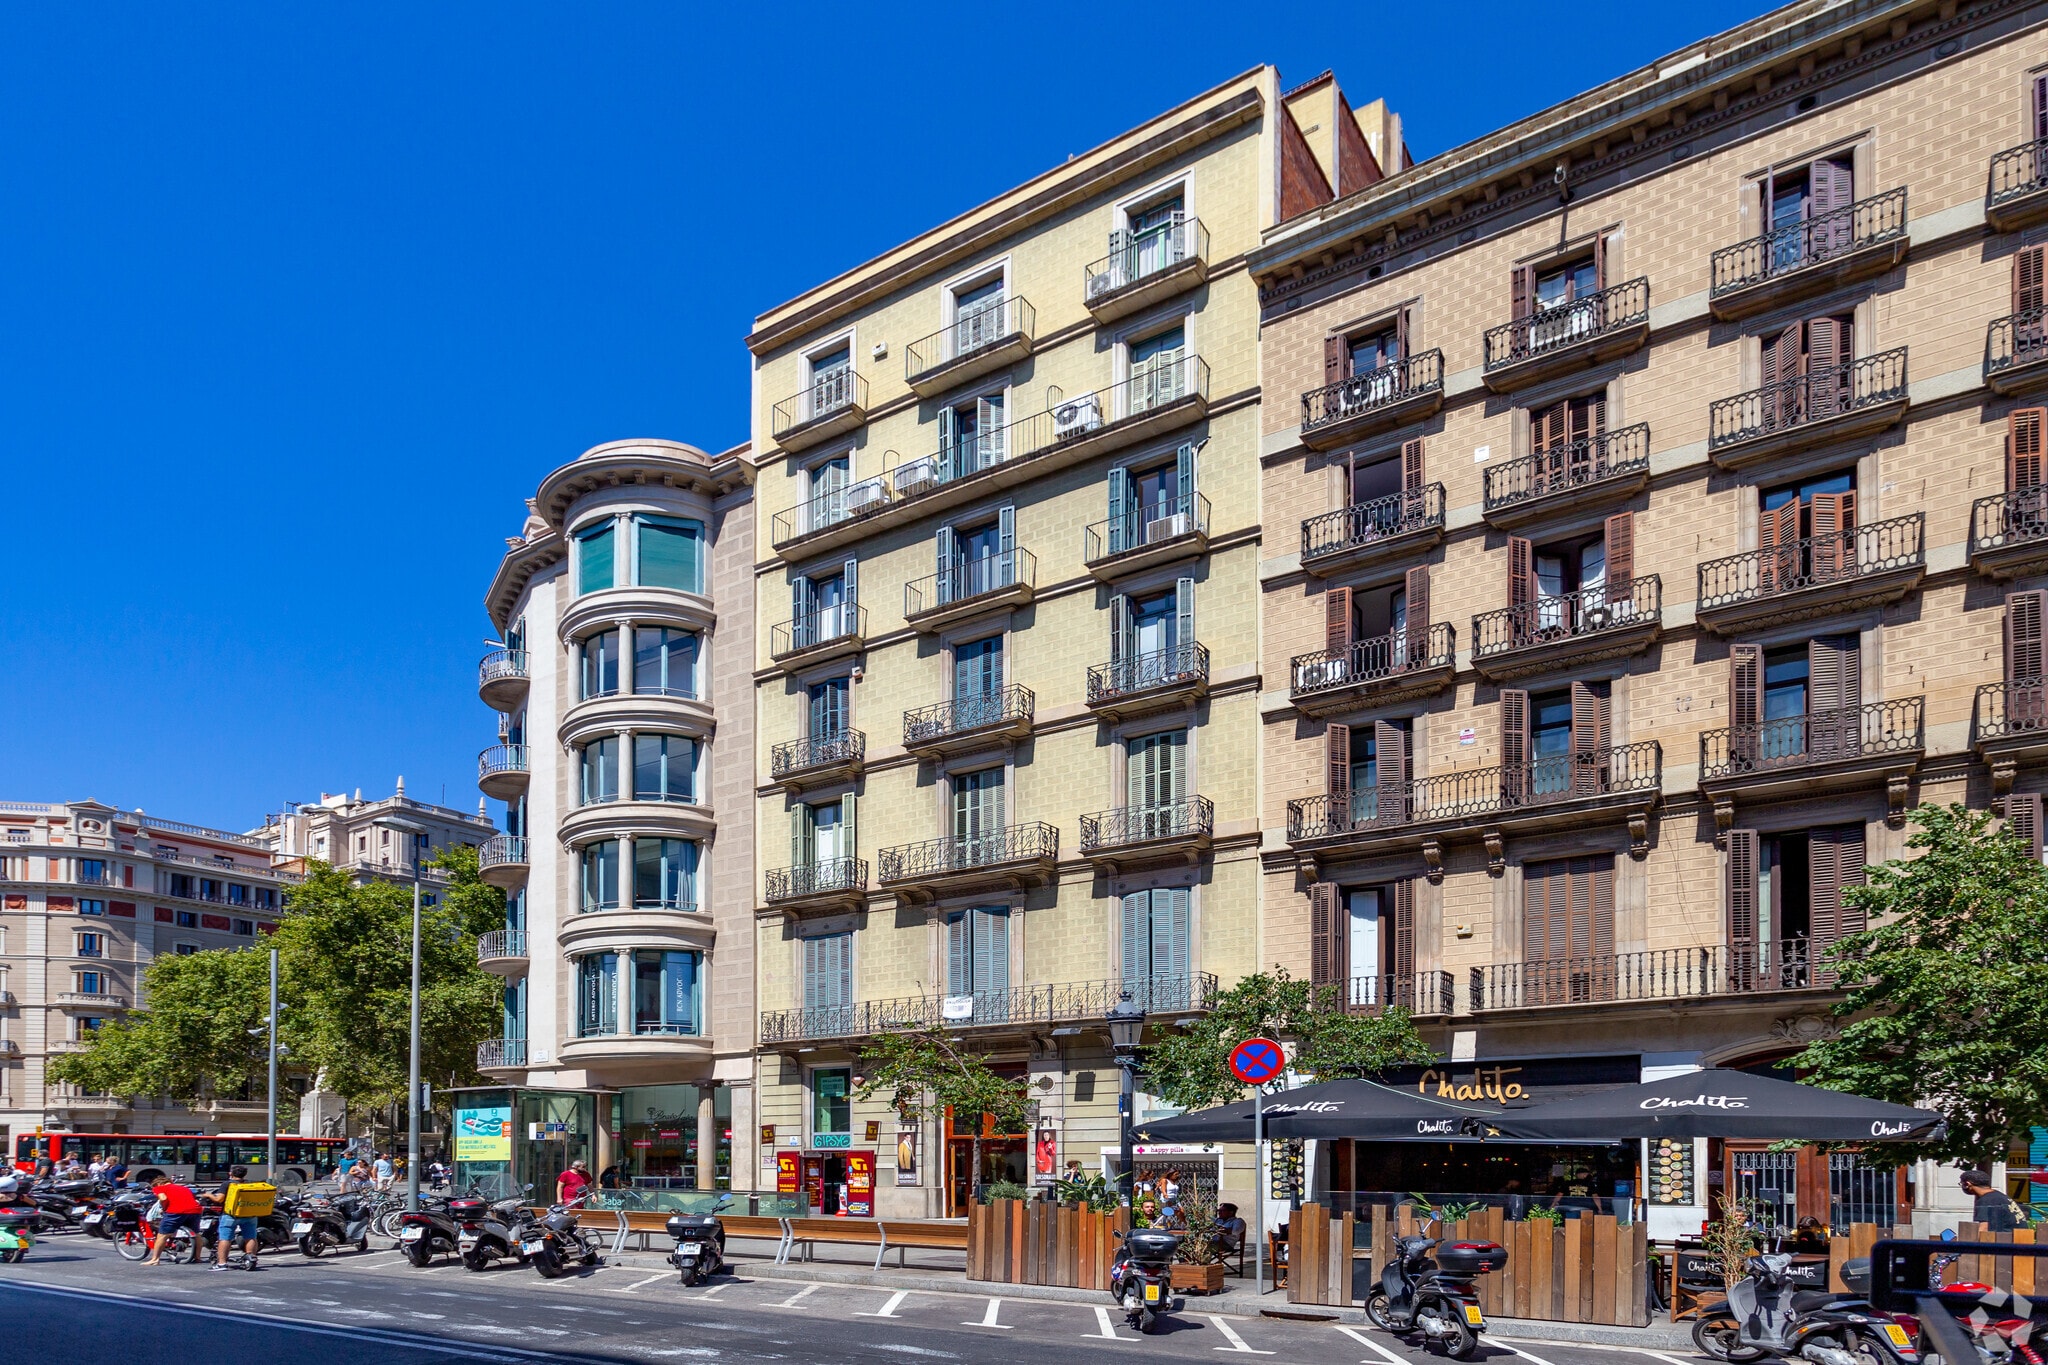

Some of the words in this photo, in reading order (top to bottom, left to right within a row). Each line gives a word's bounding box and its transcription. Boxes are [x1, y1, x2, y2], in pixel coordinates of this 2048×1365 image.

[1151, 1146, 1169, 1154] happy
[1170, 1146, 1184, 1154] pills
[1782, 1265, 1816, 1279] halito.
